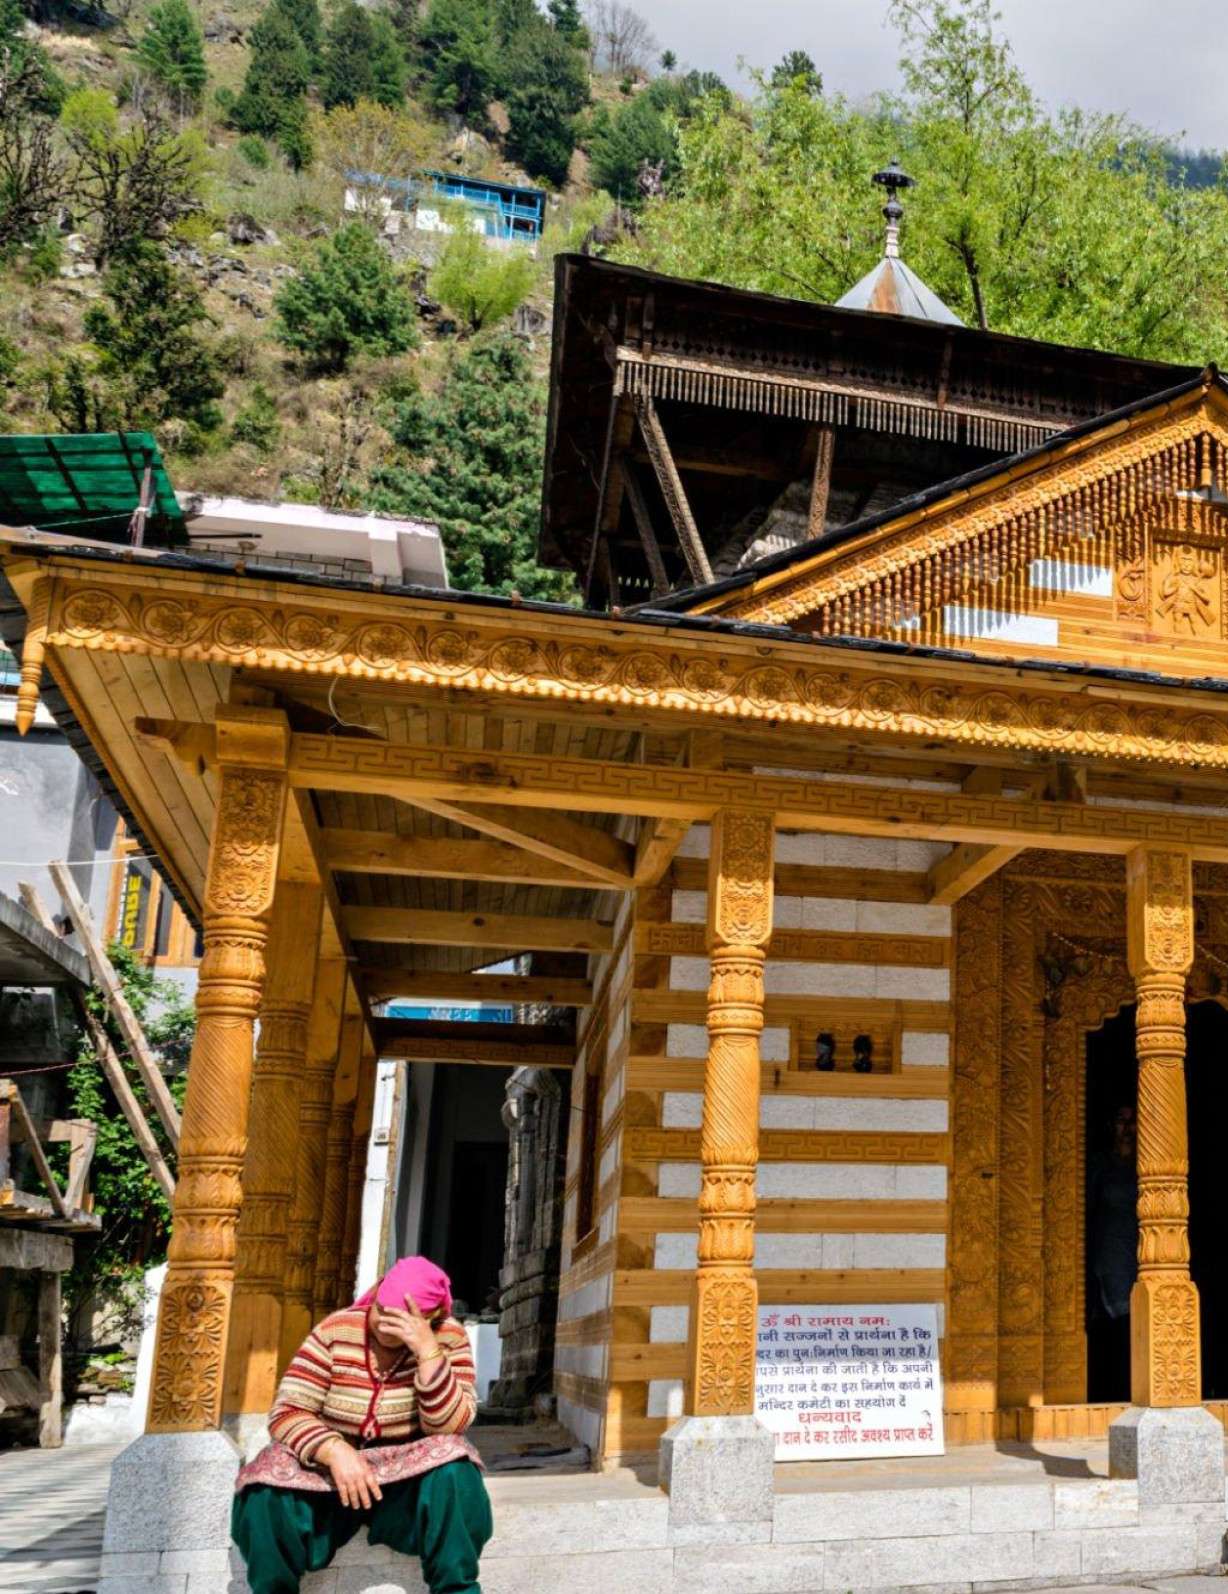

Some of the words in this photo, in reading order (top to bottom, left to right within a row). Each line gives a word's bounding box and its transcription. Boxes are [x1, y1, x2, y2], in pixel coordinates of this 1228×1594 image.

[783, 1313, 801, 1327] श्री
[808, 1316, 853, 1327] रामाय
[837, 1327, 849, 1341] से
[854, 1327, 896, 1340] प्रार्थना
[897, 1327, 909, 1341] है
[912, 1327, 931, 1340] कि
[775, 1348, 789, 1358] का
[851, 1344, 878, 1358] किया
[881, 1347, 895, 1357] जा
[898, 1347, 915, 1359] रहा
[841, 1361, 867, 1374] जाती
[882, 1361, 897, 1374] कि
[902, 1361, 933, 1374] अपनी
[788, 1383, 807, 1393] दान
[821, 1382, 838, 1392] कर
[841, 1382, 858, 1394] इस
[861, 1378, 895, 1391] निर्माण
[797, 1396, 831, 1410] कमेटी
[835, 1399, 850, 1409] का
[855, 1395, 895, 1410] सहयोग
[799, 1411, 861, 1424] धन्यवाद
[784, 1432, 801, 1446] दान
[814, 1431, 829, 1444] कर
[861, 1428, 890, 1442] अवश्य
